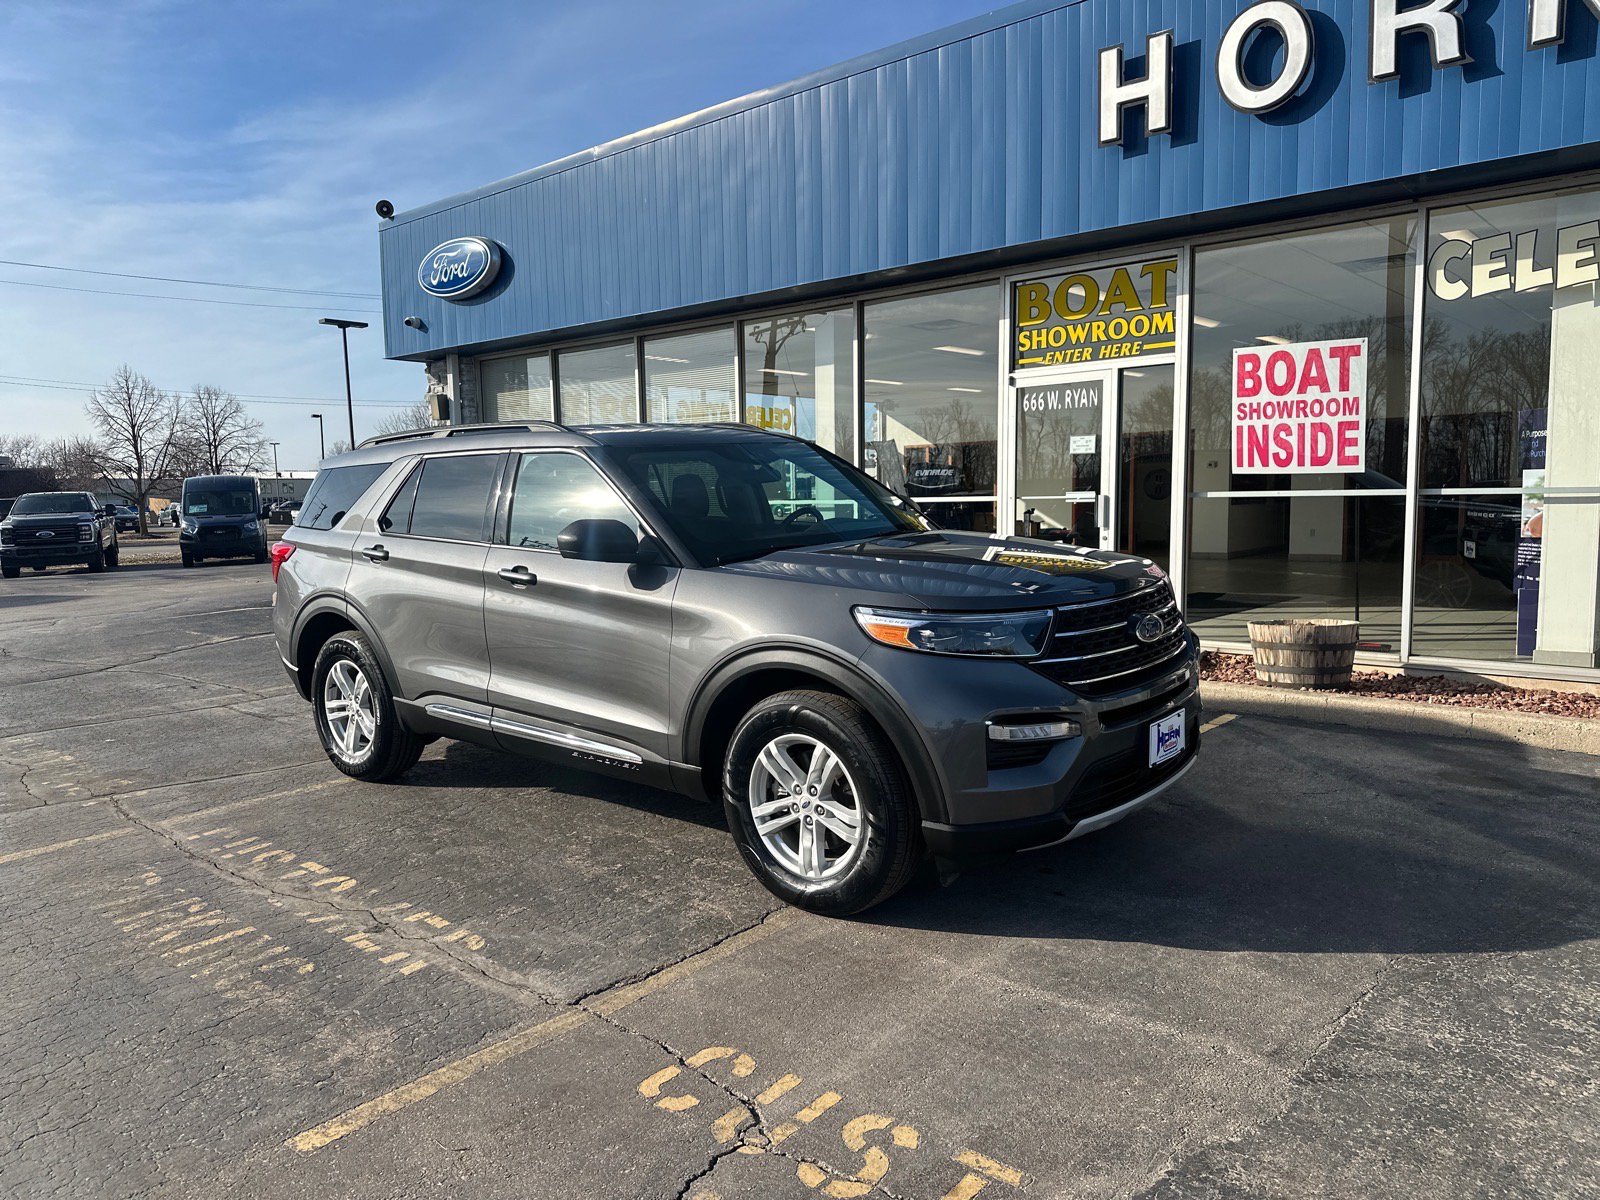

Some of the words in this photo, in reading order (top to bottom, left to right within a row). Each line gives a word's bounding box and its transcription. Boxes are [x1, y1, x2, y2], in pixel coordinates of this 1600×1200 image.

[430, 249, 471, 286] Ford
[1017, 260, 1178, 327] BOAT
[1018, 311, 1175, 352] SHOWROOM
[1043, 350, 1092, 365] ENTER
[1099, 341, 1142, 359] HERE
[1236, 344, 1361, 398] BOAT
[1023, 391, 1045, 412] 666
[1048, 388, 1062, 410] W.
[1065, 387, 1099, 408] RYAN
[1236, 396, 1360, 421] SHOWROOM
[1236, 420, 1360, 468] INSIDE
[915, 468, 954, 477] EVINRUDE
